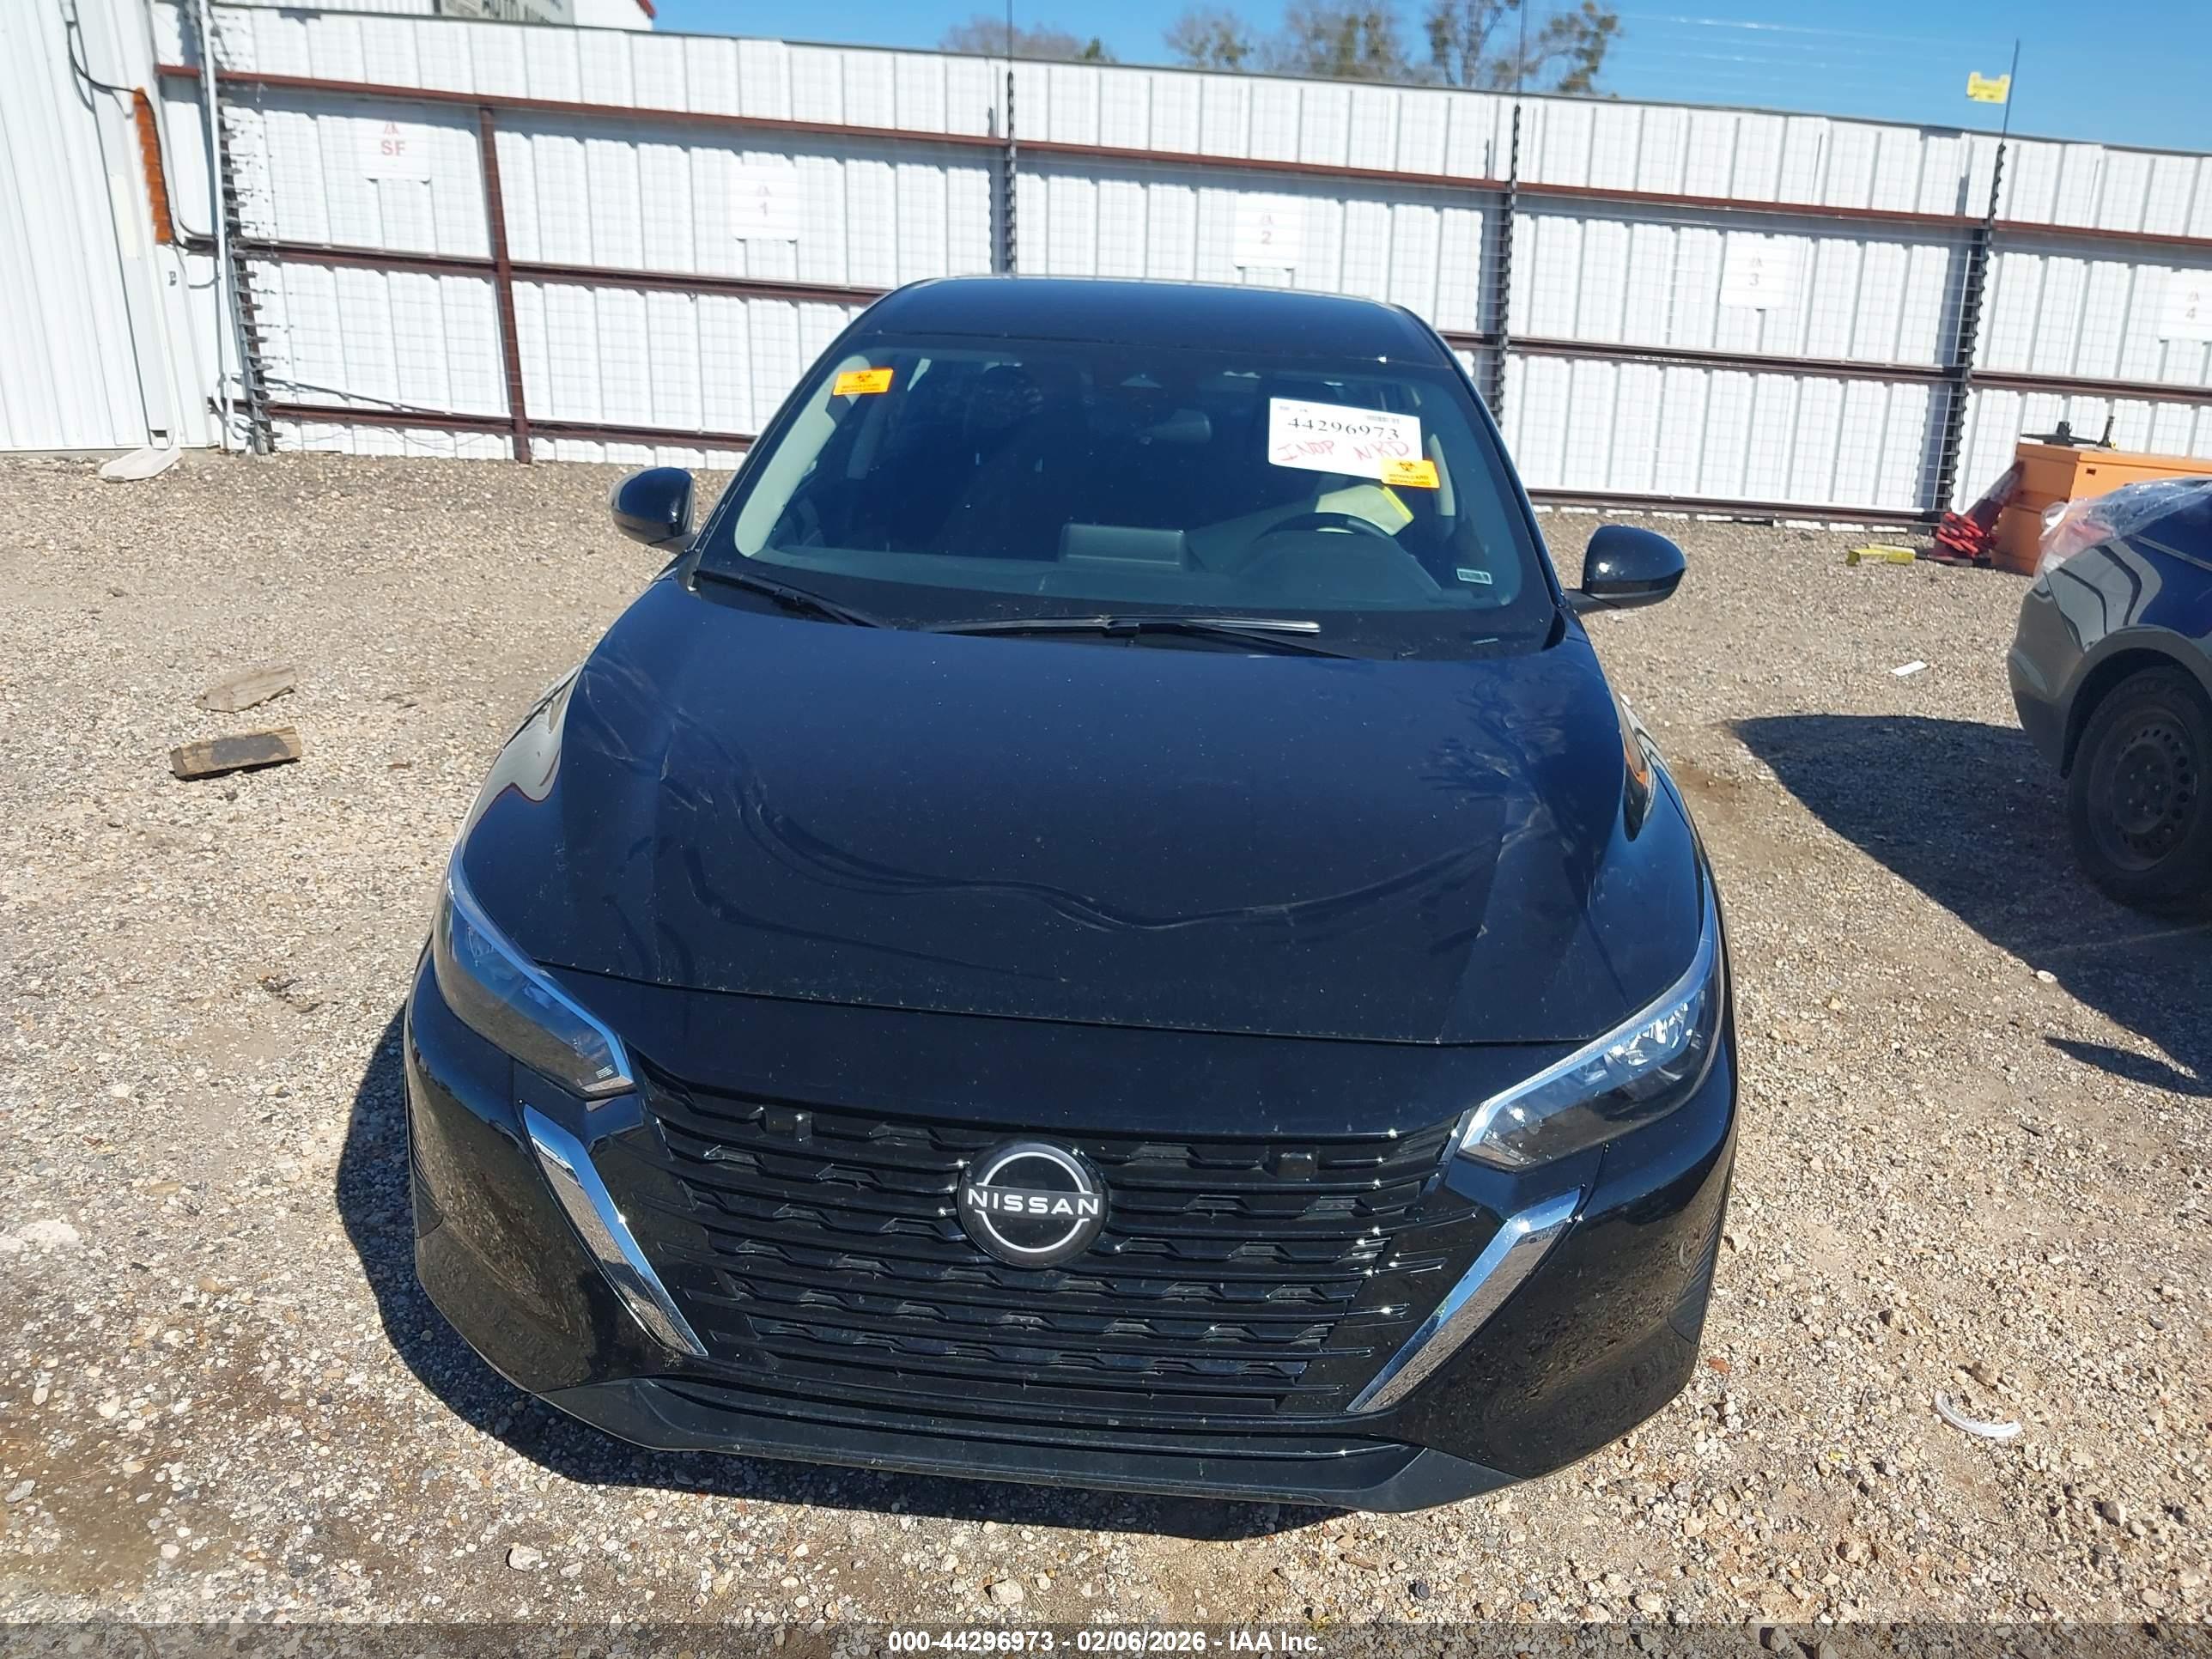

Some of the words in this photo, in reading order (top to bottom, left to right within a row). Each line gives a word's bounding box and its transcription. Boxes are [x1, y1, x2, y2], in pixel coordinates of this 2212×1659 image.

[380, 140, 406, 156] SF
[761, 202, 769, 216] 1
[1261, 231, 1272, 245] 2
[1749, 273, 1759, 287] 3
[2186, 307, 2197, 320] 4
[1288, 417, 1399, 440] 44296973
[968, 1188, 1098, 1215] NISSAN
